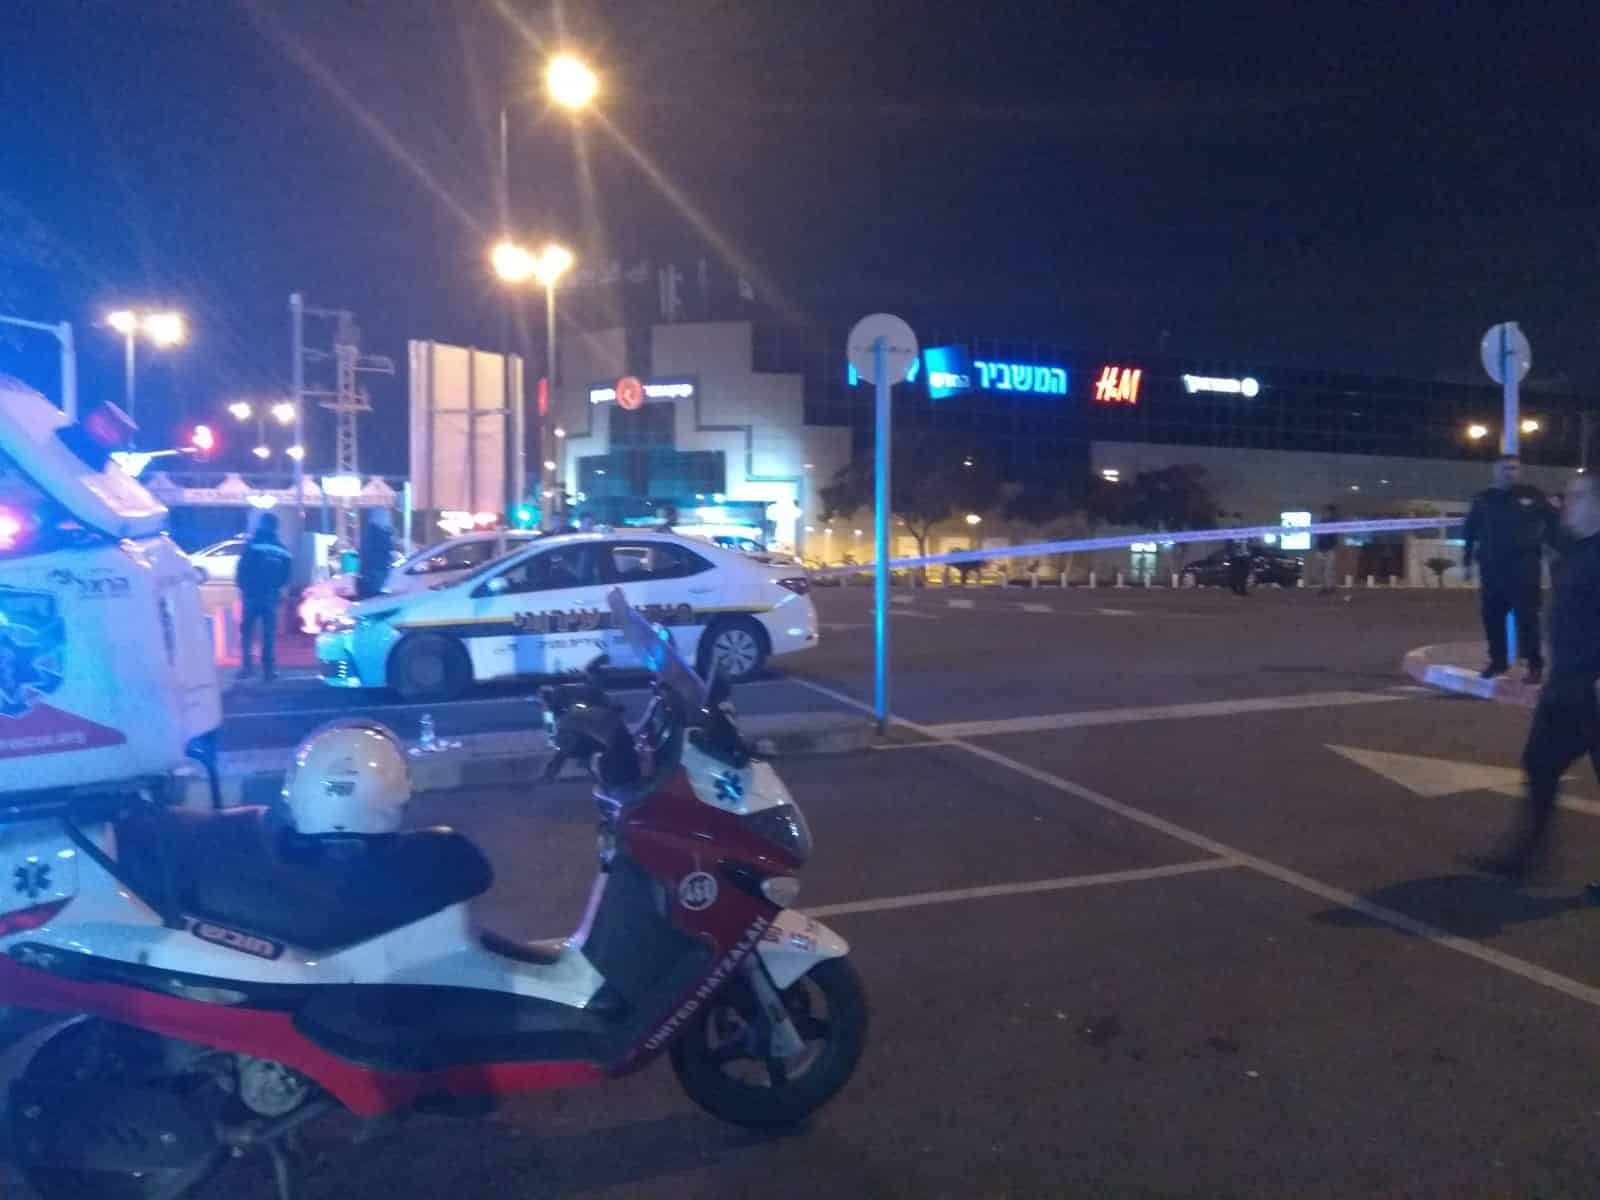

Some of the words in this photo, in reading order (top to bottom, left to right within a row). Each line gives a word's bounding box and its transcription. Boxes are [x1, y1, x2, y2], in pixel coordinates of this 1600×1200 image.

[973, 360, 1067, 395] המשביר
[1095, 365, 1142, 404] H&M
[644, 1000, 699, 1050] UNITED
